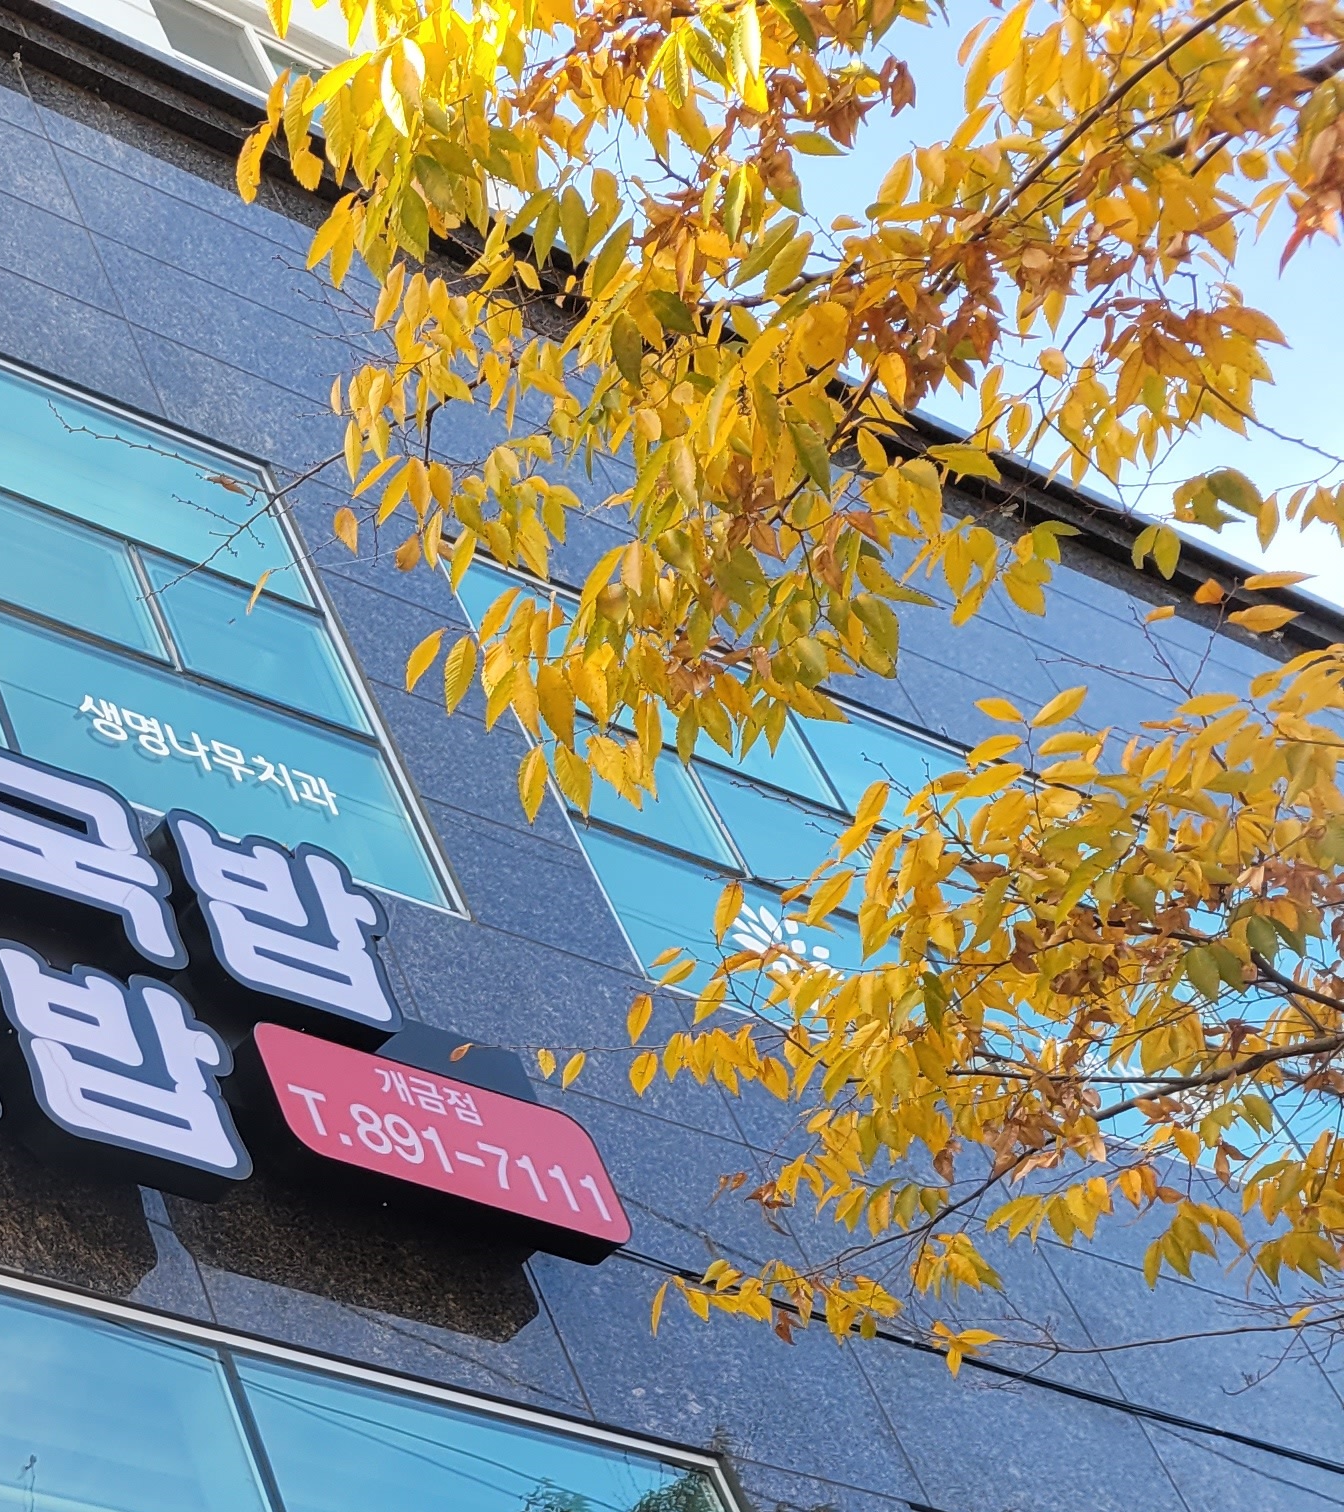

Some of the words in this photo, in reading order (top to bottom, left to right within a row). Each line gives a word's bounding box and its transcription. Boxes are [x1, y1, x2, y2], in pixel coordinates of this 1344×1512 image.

[78, 694, 339, 816] 생명나무치과
[287, 1083, 612, 1221] T.891-7111
[374, 1068, 483, 1126] 개금점
